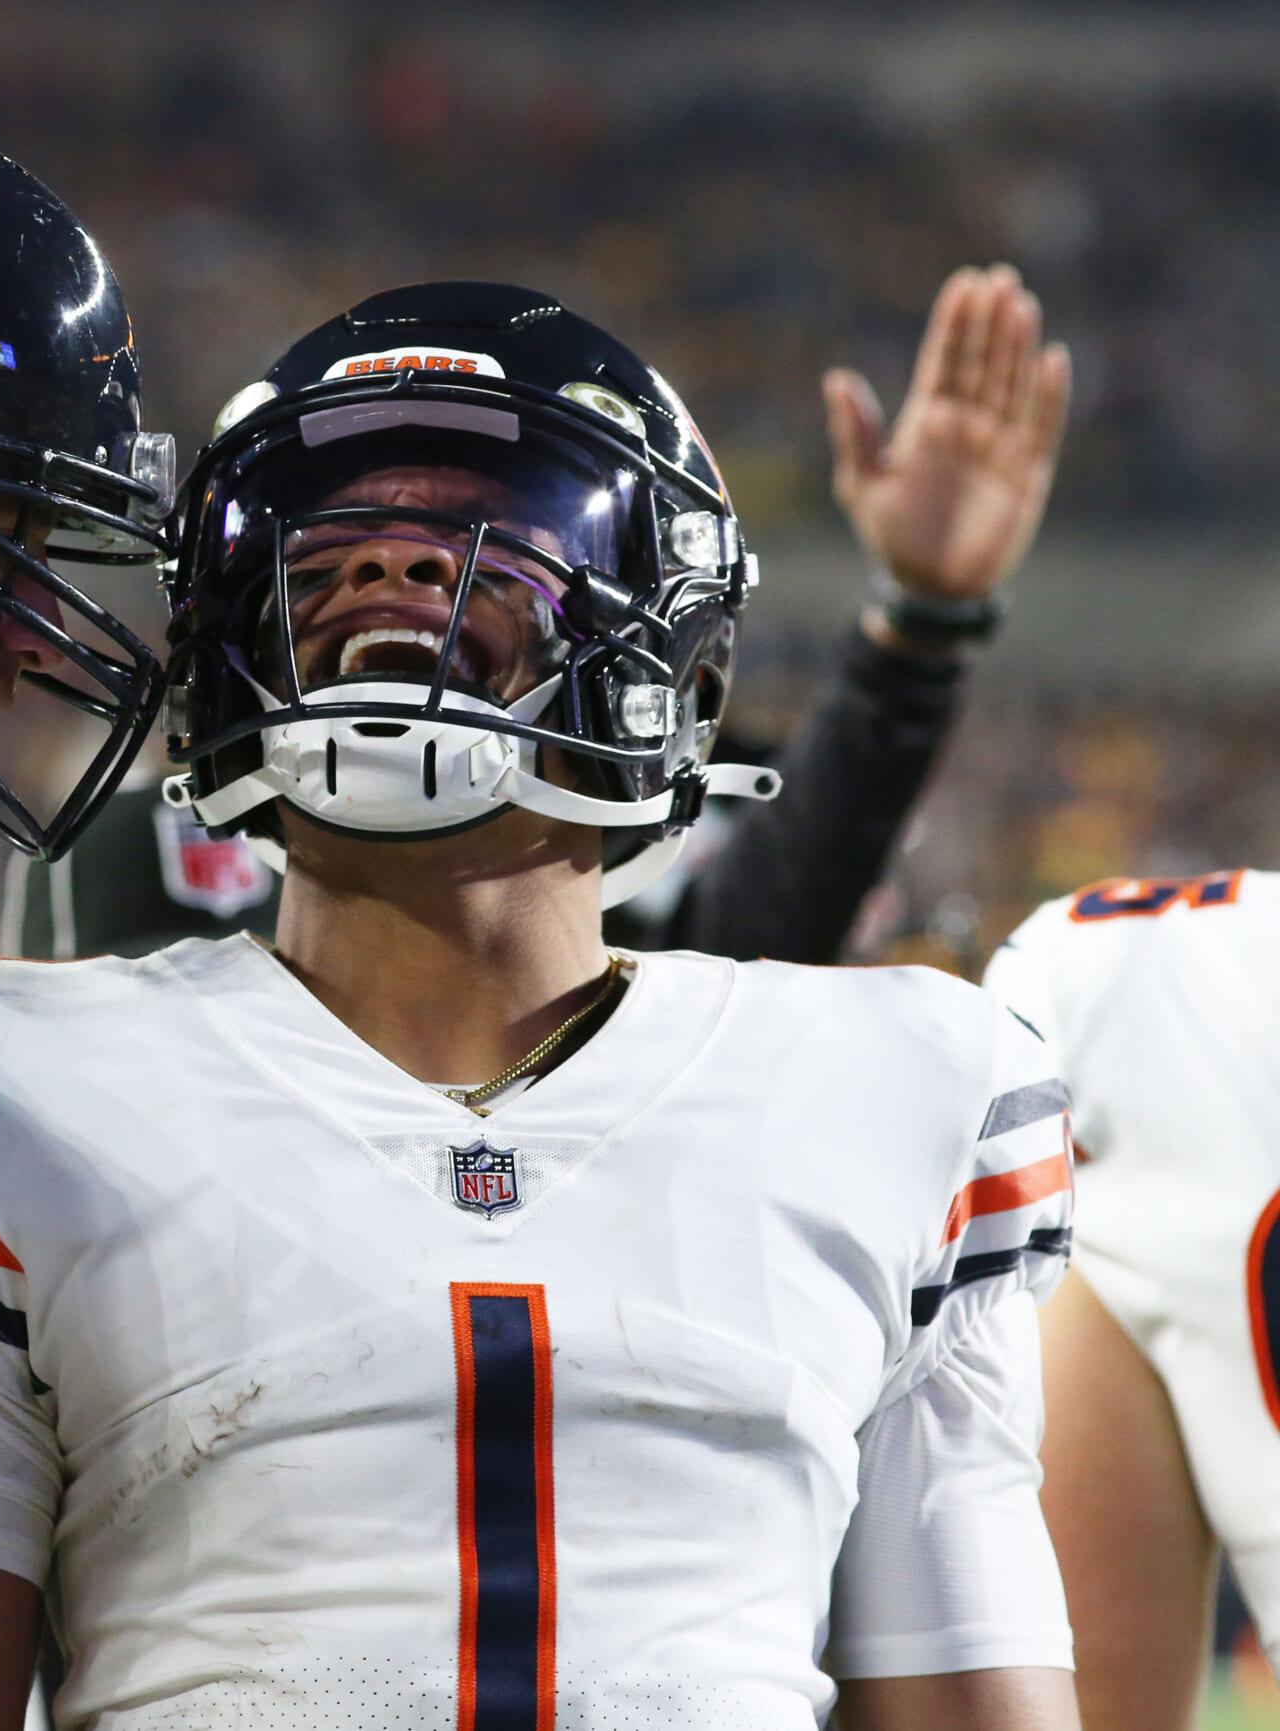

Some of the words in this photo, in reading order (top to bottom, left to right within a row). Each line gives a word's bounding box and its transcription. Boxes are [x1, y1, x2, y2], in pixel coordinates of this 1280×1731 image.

[346, 356, 477, 376] BEARS
[461, 1174, 512, 1202] NFL
[449, 1281, 557, 1731] 1
